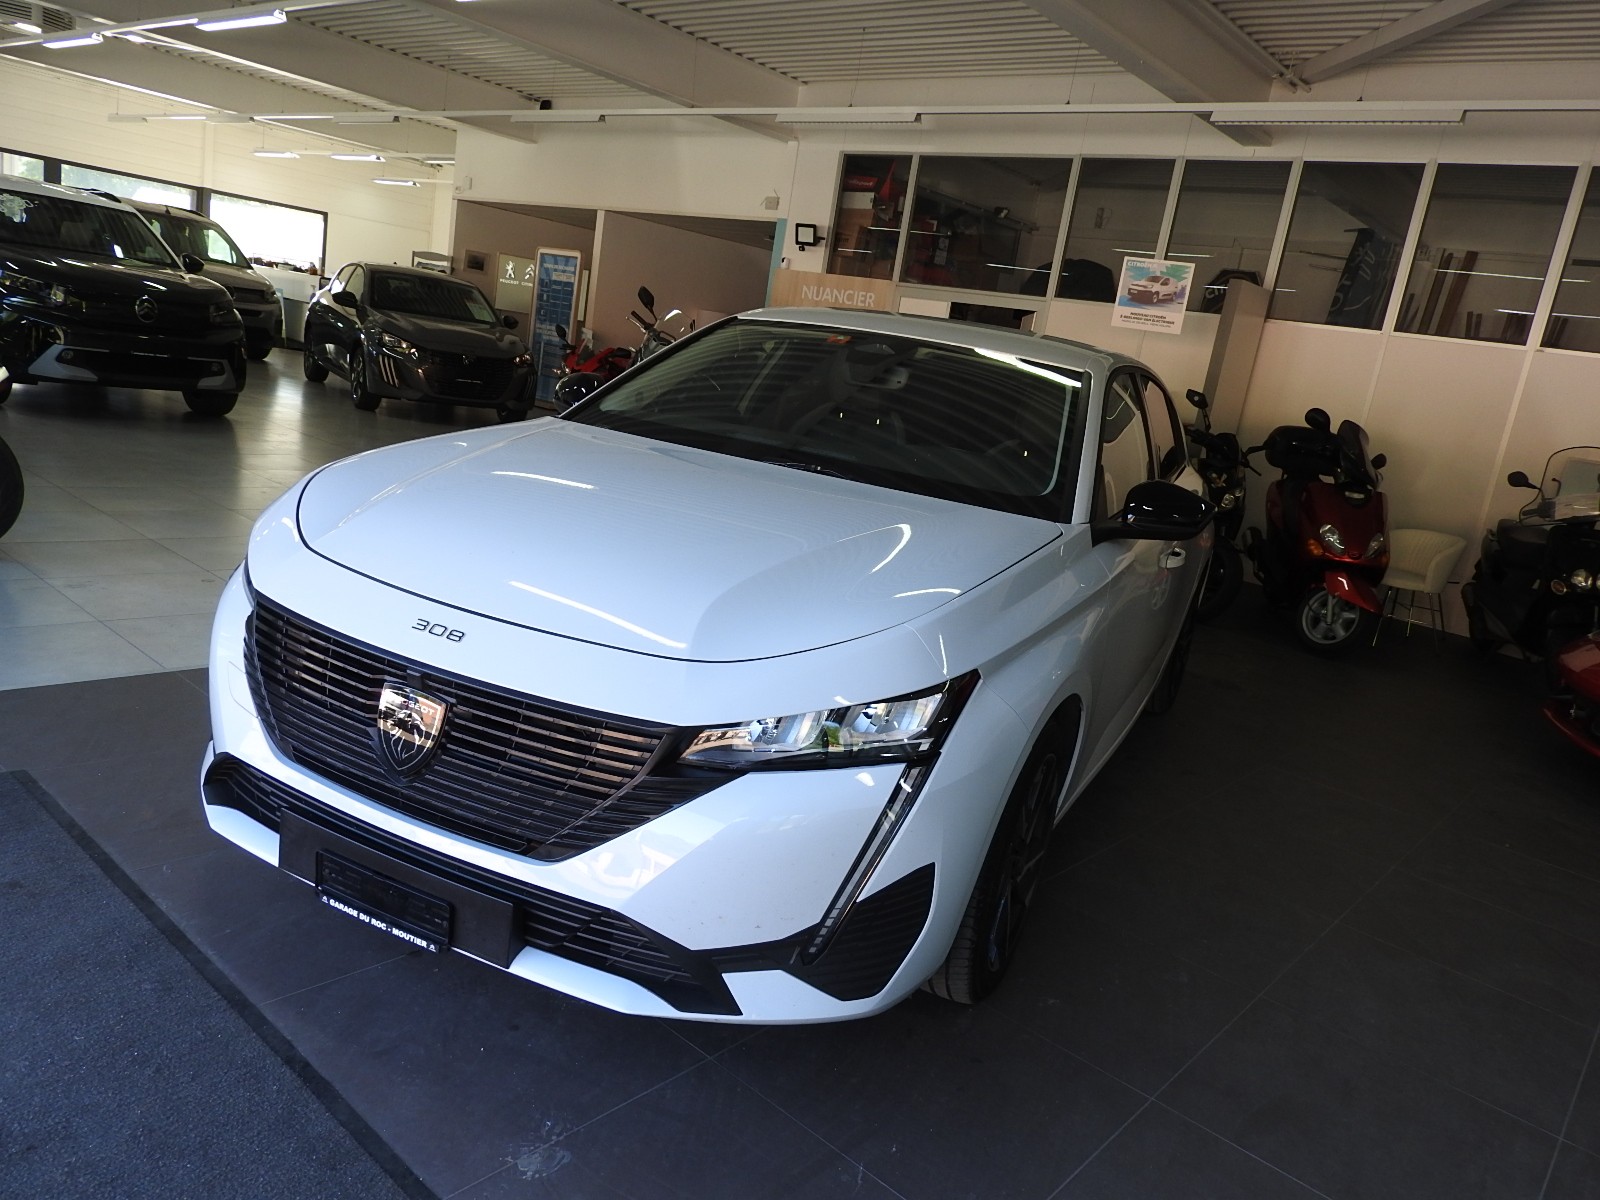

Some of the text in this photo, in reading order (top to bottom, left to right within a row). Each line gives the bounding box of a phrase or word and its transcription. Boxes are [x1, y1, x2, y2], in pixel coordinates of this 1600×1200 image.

[801, 285, 875, 307] NUANCIER
[412, 618, 465, 642] 308
[329, 899, 358, 918] GARAGE
[359, 912, 370, 923] DU
[371, 918, 387, 931] ROC
[392, 927, 427, 949] MOUTIER
